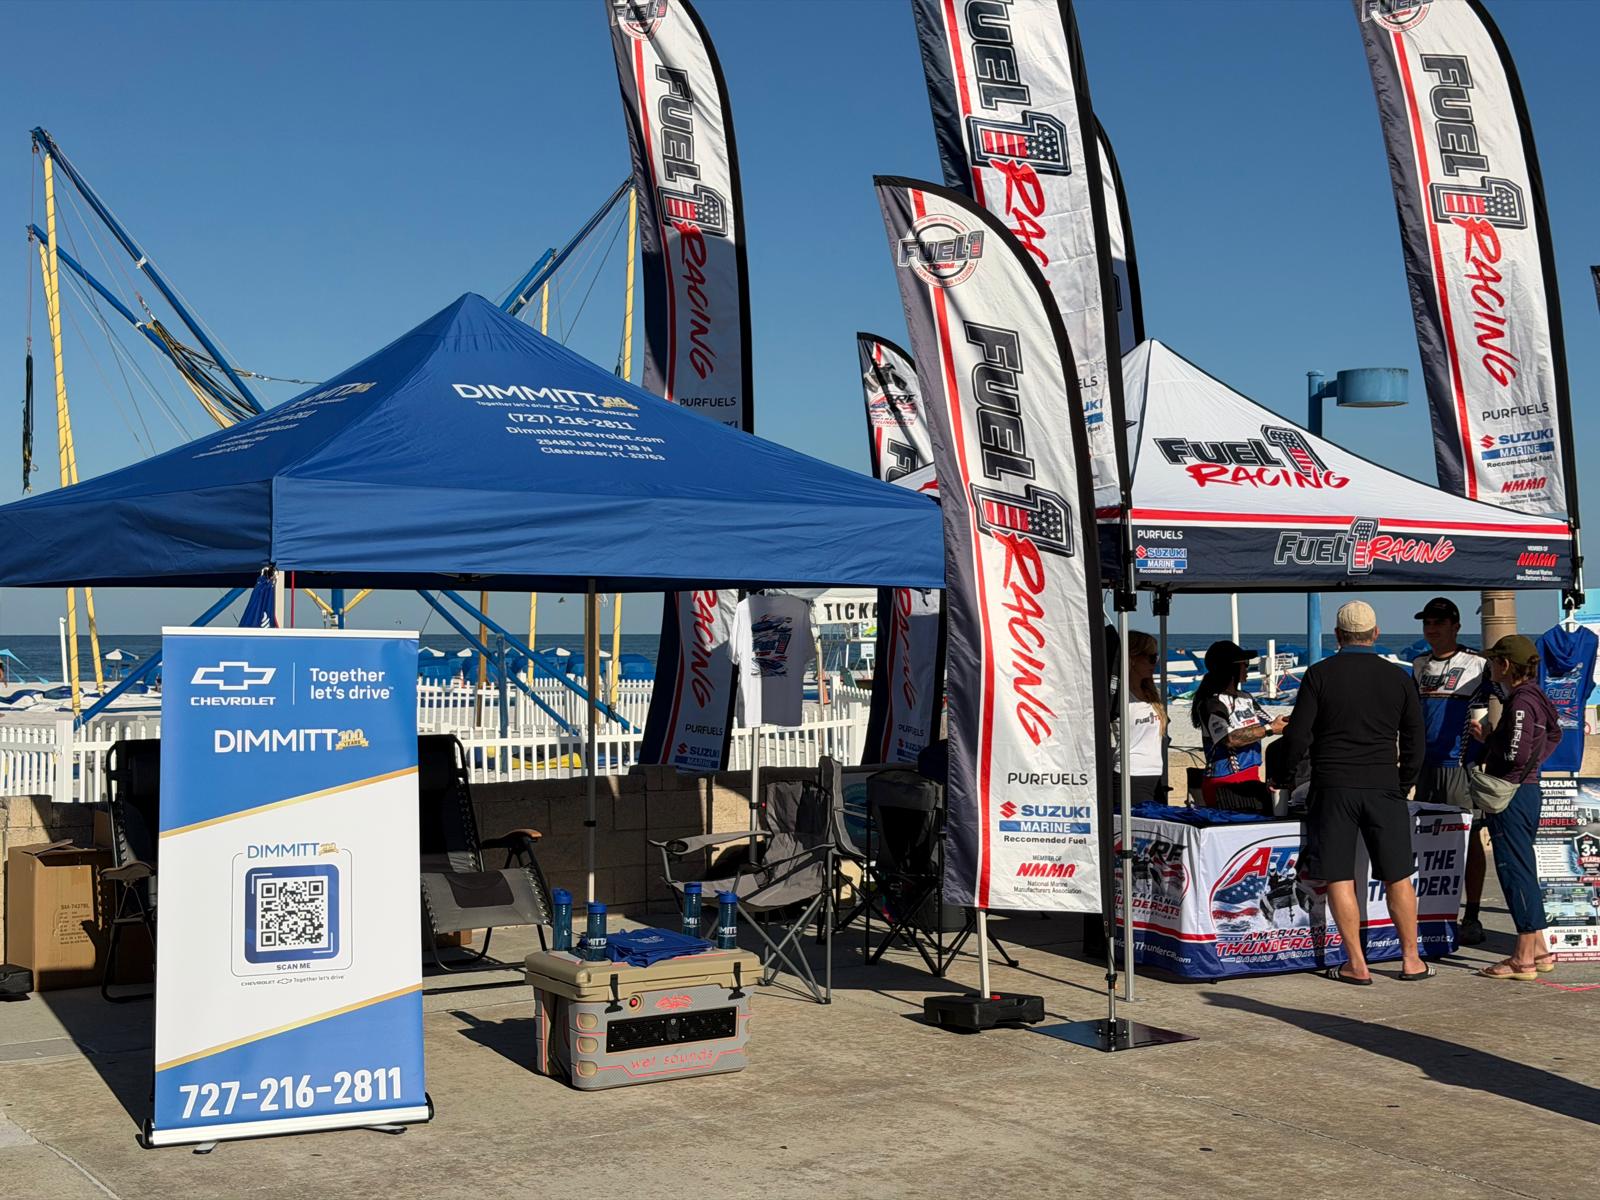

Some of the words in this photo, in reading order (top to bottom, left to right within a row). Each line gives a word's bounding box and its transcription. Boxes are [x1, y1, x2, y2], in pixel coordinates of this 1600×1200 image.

[671, 219, 717, 381] RACING
[1450, 215, 1520, 387] RACING
[451, 383, 599, 407] DIMMITT
[1482, 402, 1550, 421] PURFUELS
[508, 412, 553, 424] (727)
[555, 415, 636, 431] 216-2811
[506, 426, 665, 444] DimmittChevrolet.com
[1498, 428, 1554, 445] SUZUKI
[576, 440, 596, 448] US
[597, 442, 623, 452] Hwy
[1499, 444, 1541, 458] MARINE
[1185, 463, 1351, 489] RACING
[1137, 529, 1184, 540] PURFUELS
[1147, 548, 1188, 558] SUZUKI
[1366, 536, 1456, 566] RACING
[1147, 560, 1176, 568] MARINE
[991, 530, 1058, 746] RACING
[310, 668, 385, 683] Together
[310, 685, 345, 700] let's
[191, 697, 276, 706] CHEVROLET
[685, 723, 724, 737] PURFUELS
[214, 729, 338, 753] DIMMITT
[338, 729, 364, 742] 100
[1007, 772, 1088, 786] PURFUELS
[1020, 804, 1091, 819] SUZUKI
[1020, 822, 1071, 833] MARINE
[1068, 836, 1087, 845] Fuel
[247, 843, 319, 858] DIMMITT
[1581, 844, 1598, 857] 3+
[1424, 849, 1457, 872] THE
[1216, 933, 1344, 957] THUNDERCATS
[180, 1066, 402, 1119] 727-216-2811
